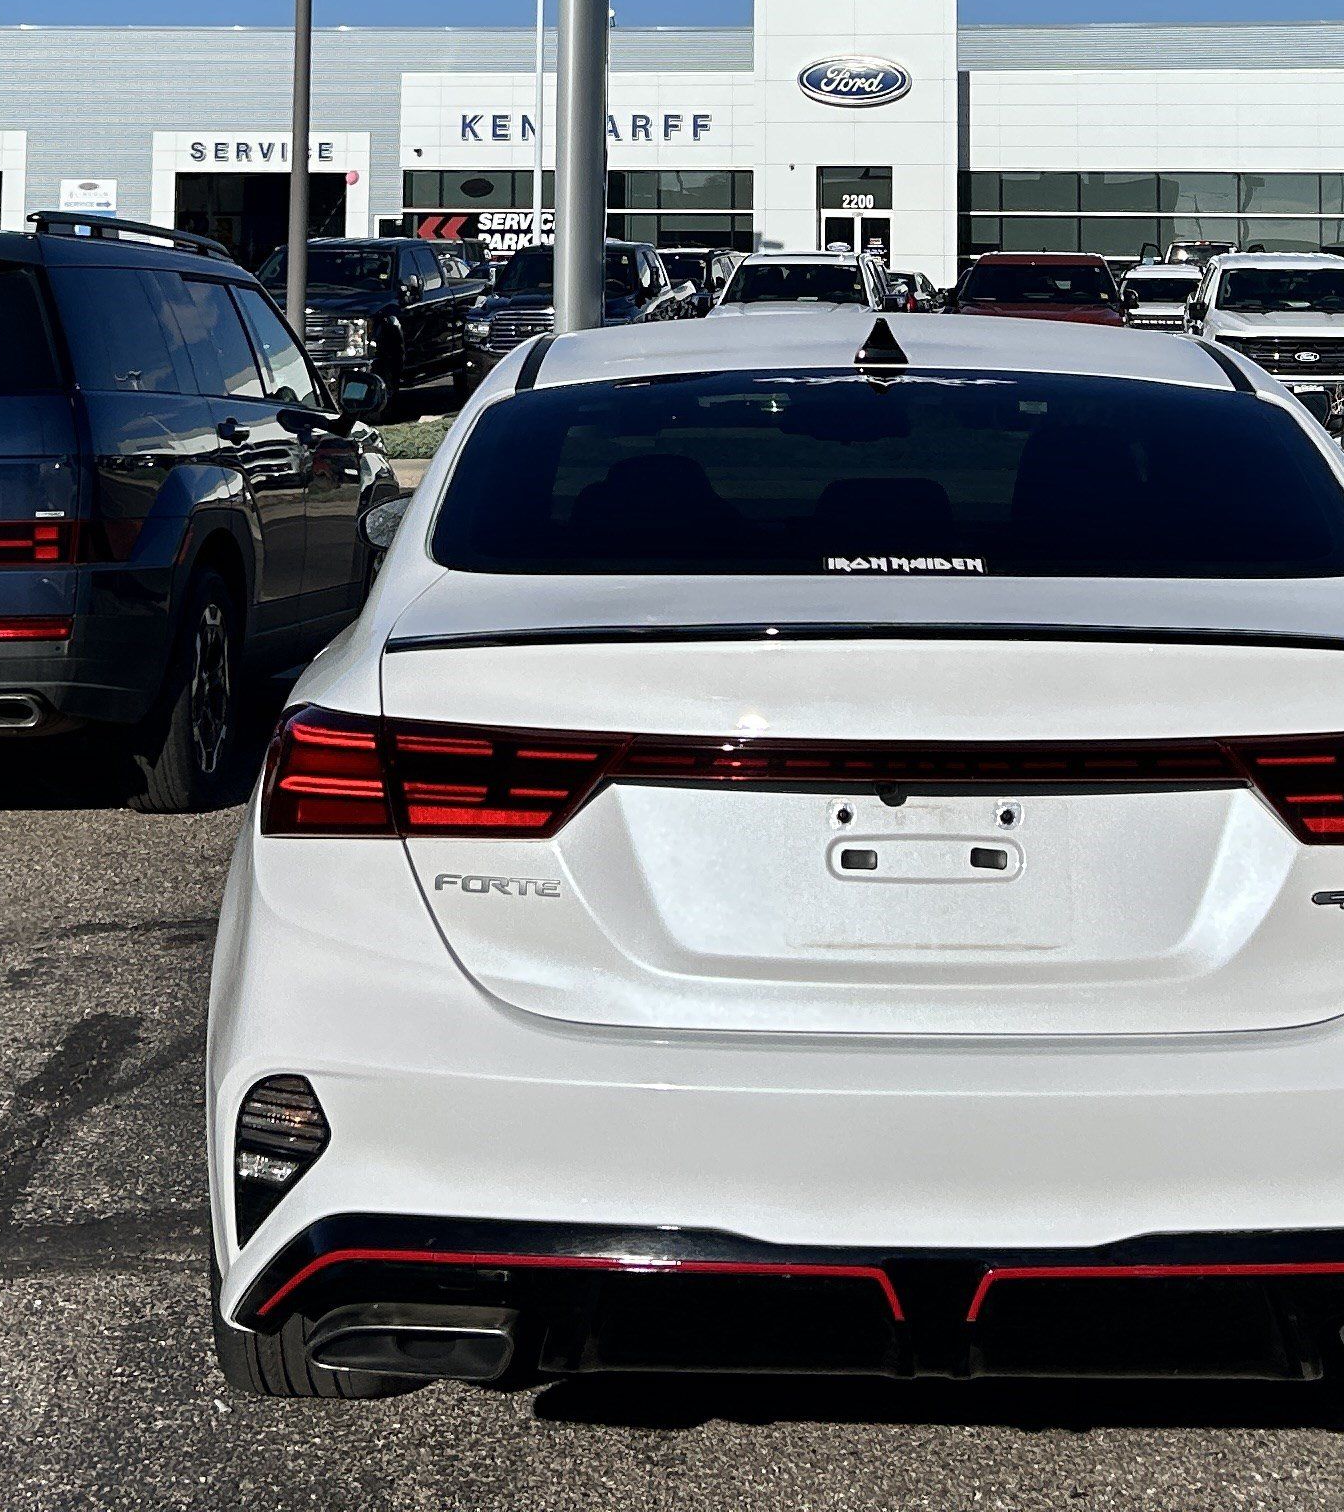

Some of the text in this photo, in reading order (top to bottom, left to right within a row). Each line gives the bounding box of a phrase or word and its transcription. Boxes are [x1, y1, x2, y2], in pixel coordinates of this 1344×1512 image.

[820, 66, 885, 92] Ford
[461, 114, 712, 141] KEN ARFF
[190, 141, 334, 162] SERVIE
[842, 194, 874, 209] 2200
[477, 212, 556, 230] SERVC
[478, 232, 556, 250] PARKN
[827, 556, 984, 574] IRON MAIDEN
[434, 873, 561, 898] FORTE
